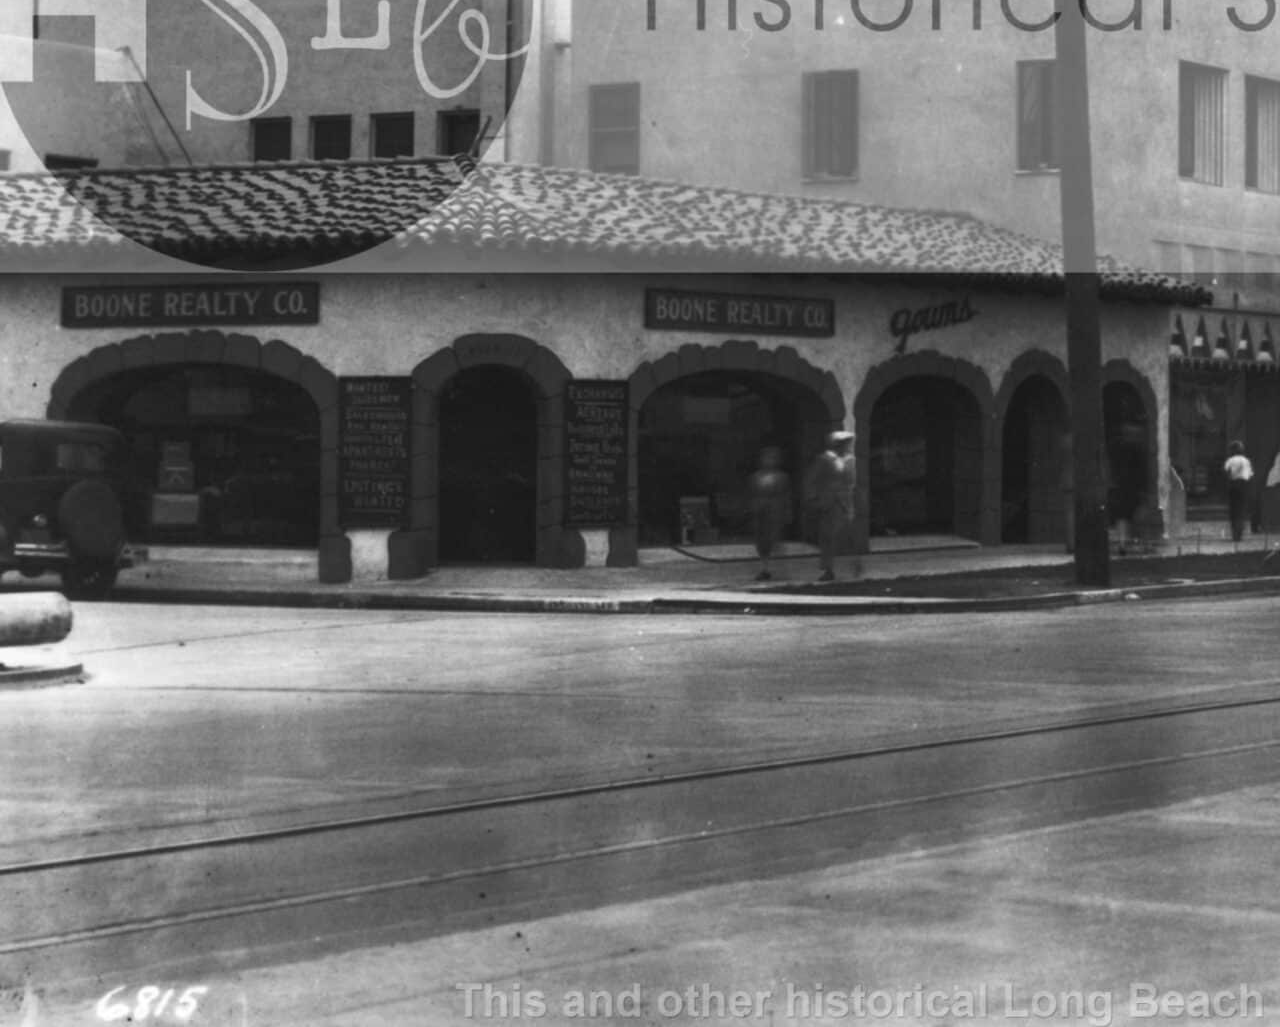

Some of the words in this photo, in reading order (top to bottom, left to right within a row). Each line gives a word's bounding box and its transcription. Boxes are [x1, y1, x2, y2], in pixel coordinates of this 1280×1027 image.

[74, 293, 152, 318] BOONE
[164, 291, 261, 317] REALTY
[272, 289, 309, 315] CO.
[655, 295, 718, 322] BOONE
[727, 300, 795, 327] REALTY
